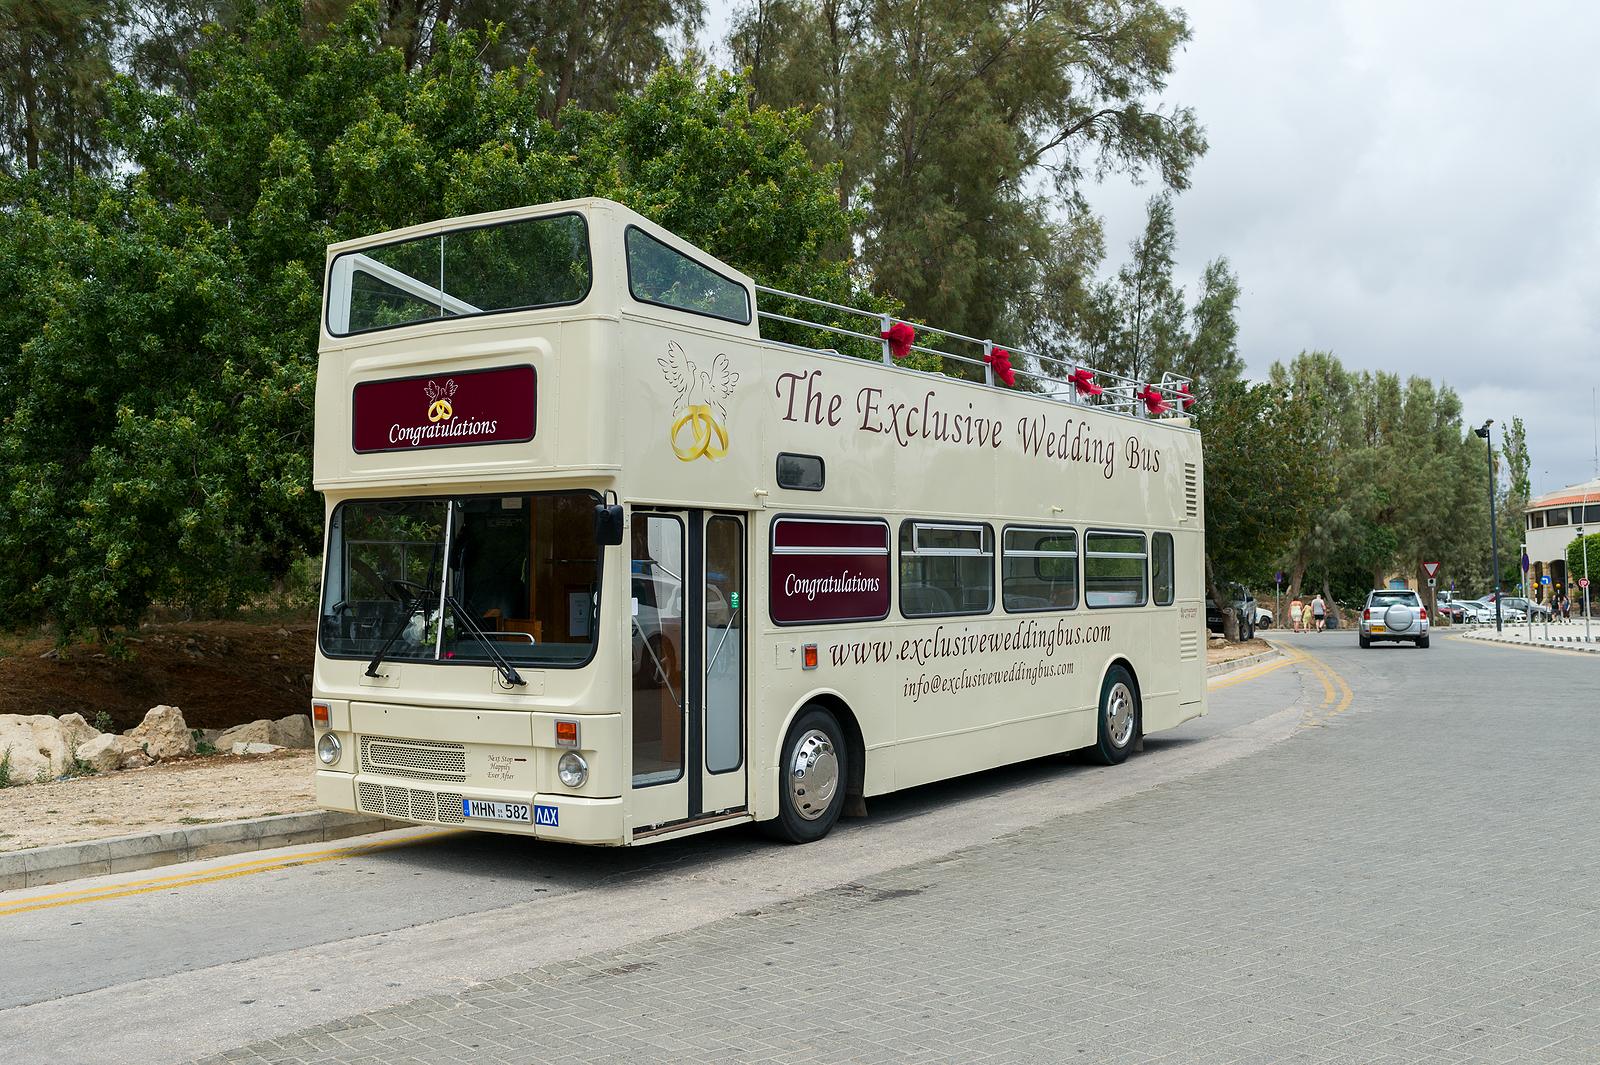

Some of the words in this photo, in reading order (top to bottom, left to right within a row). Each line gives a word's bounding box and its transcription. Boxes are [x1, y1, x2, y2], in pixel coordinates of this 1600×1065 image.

[388, 416, 497, 446] Congratulations
[775, 370, 842, 427] The
[856, 387, 1002, 449] Exclusive
[1017, 414, 1115, 479] Wedding
[1125, 436, 1160, 473] Bus
[785, 570, 880, 601] Congratulations
[829, 619, 1111, 668] www.exclusiveweddingbus.com
[903, 660, 1074, 702] info@exclusiveweddingbus.com
[487, 754, 500, 763] Next
[501, 756, 513, 764] Stop
[490, 763, 510, 772] Happily
[500, 771, 514, 781] After
[471, 801, 496, 817] MHN
[505, 804, 529, 820] 582
[535, 807, 558, 825] ΛΔΧ
